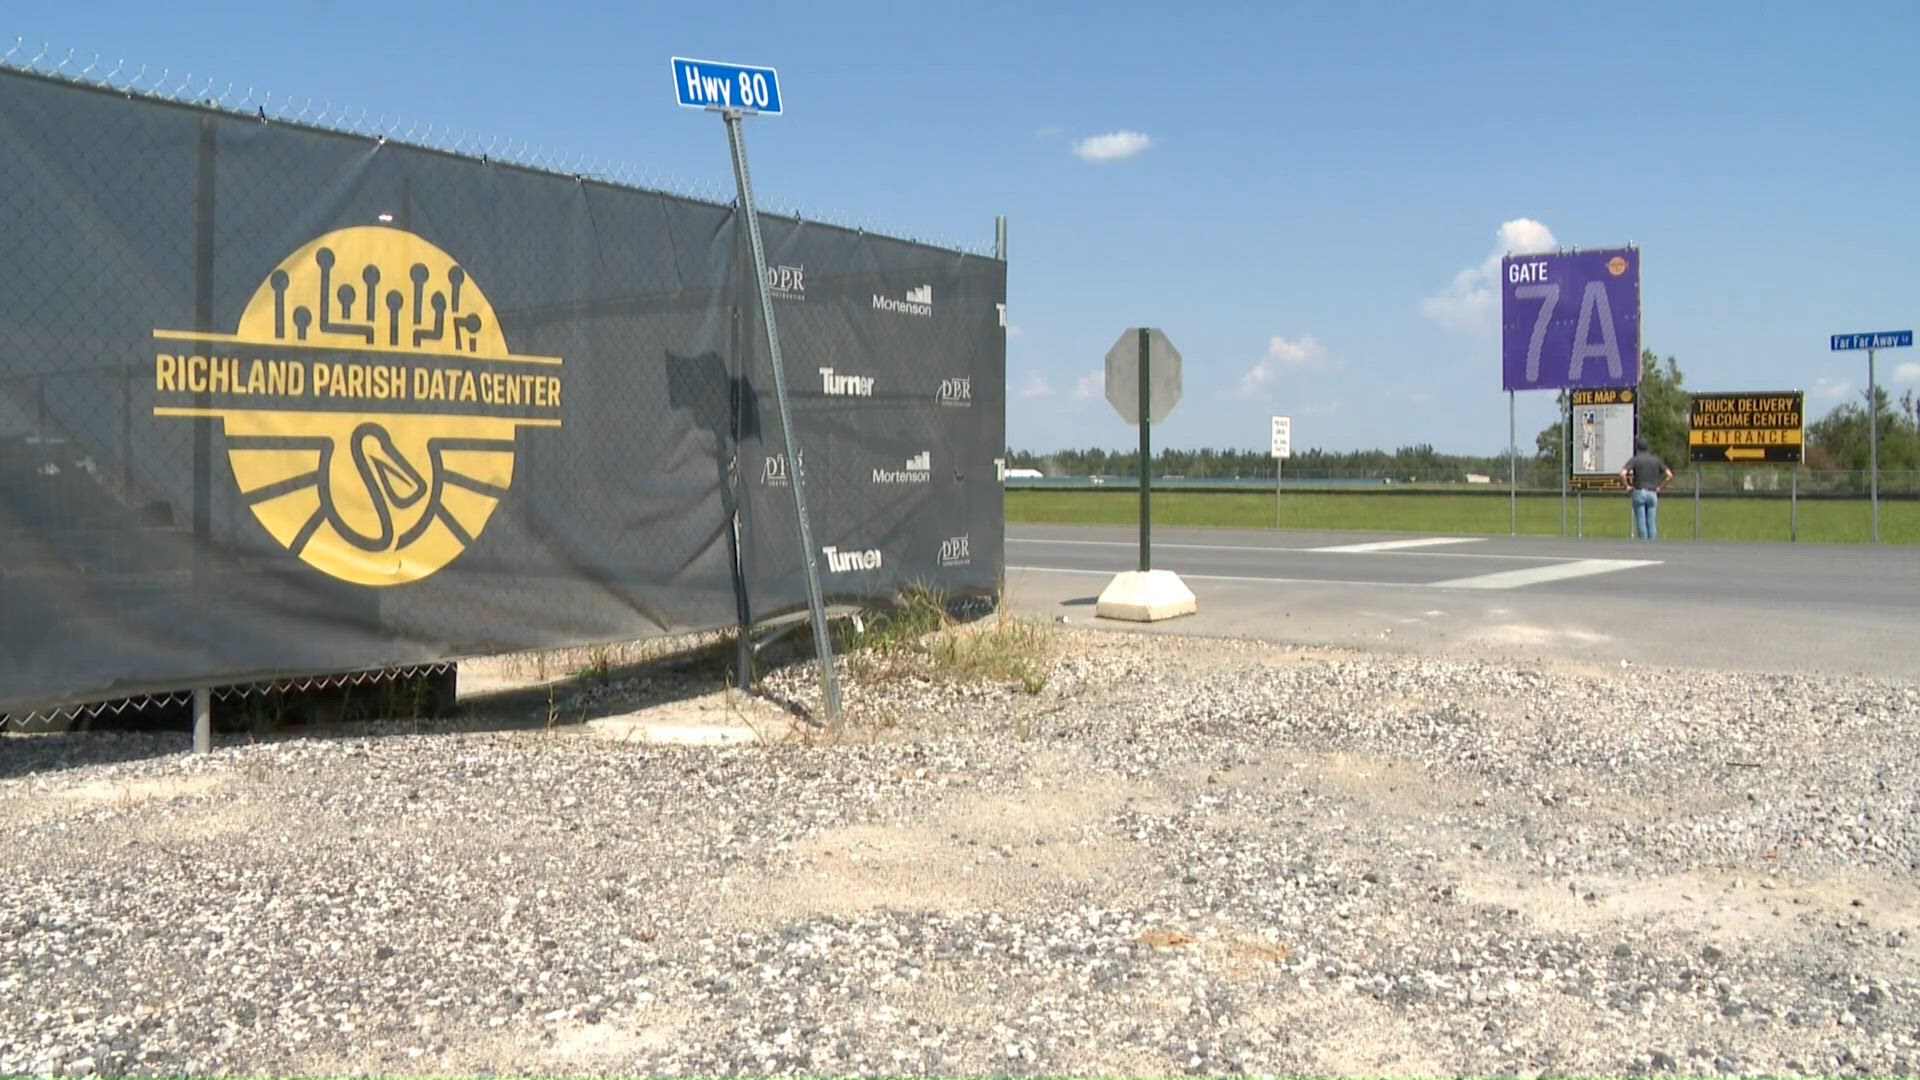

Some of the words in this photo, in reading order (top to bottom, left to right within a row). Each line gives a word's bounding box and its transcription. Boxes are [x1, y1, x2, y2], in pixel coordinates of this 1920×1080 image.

[685, 65, 730, 107] Hwy
[738, 71, 769, 107] 80
[767, 266, 804, 291] DPR
[1509, 261, 1548, 283] GATE
[872, 294, 932, 317] Mortenson
[1514, 280, 1623, 383] 7A
[1834, 335, 1850, 349] Far
[1853, 334, 1868, 348] Far
[1873, 333, 1899, 348] Away
[155, 353, 305, 397] RICHLAND
[313, 362, 406, 400] PARISH
[413, 367, 477, 403] DATA
[480, 371, 561, 407] CENTER
[819, 367, 874, 397] Turner
[942, 379, 971, 399] DPR
[1573, 391, 1593, 404] SITE
[1594, 390, 1616, 403] MAP
[1698, 399, 1735, 413] TRUCK
[1738, 398, 1793, 413] DELIVERY
[1693, 412, 1749, 426] WELCOME
[1753, 412, 1799, 426] CENTER
[1701, 430, 1789, 444] ENTRANCE
[872, 468, 930, 484] Mortenson
[942, 539, 969, 558] DPR
